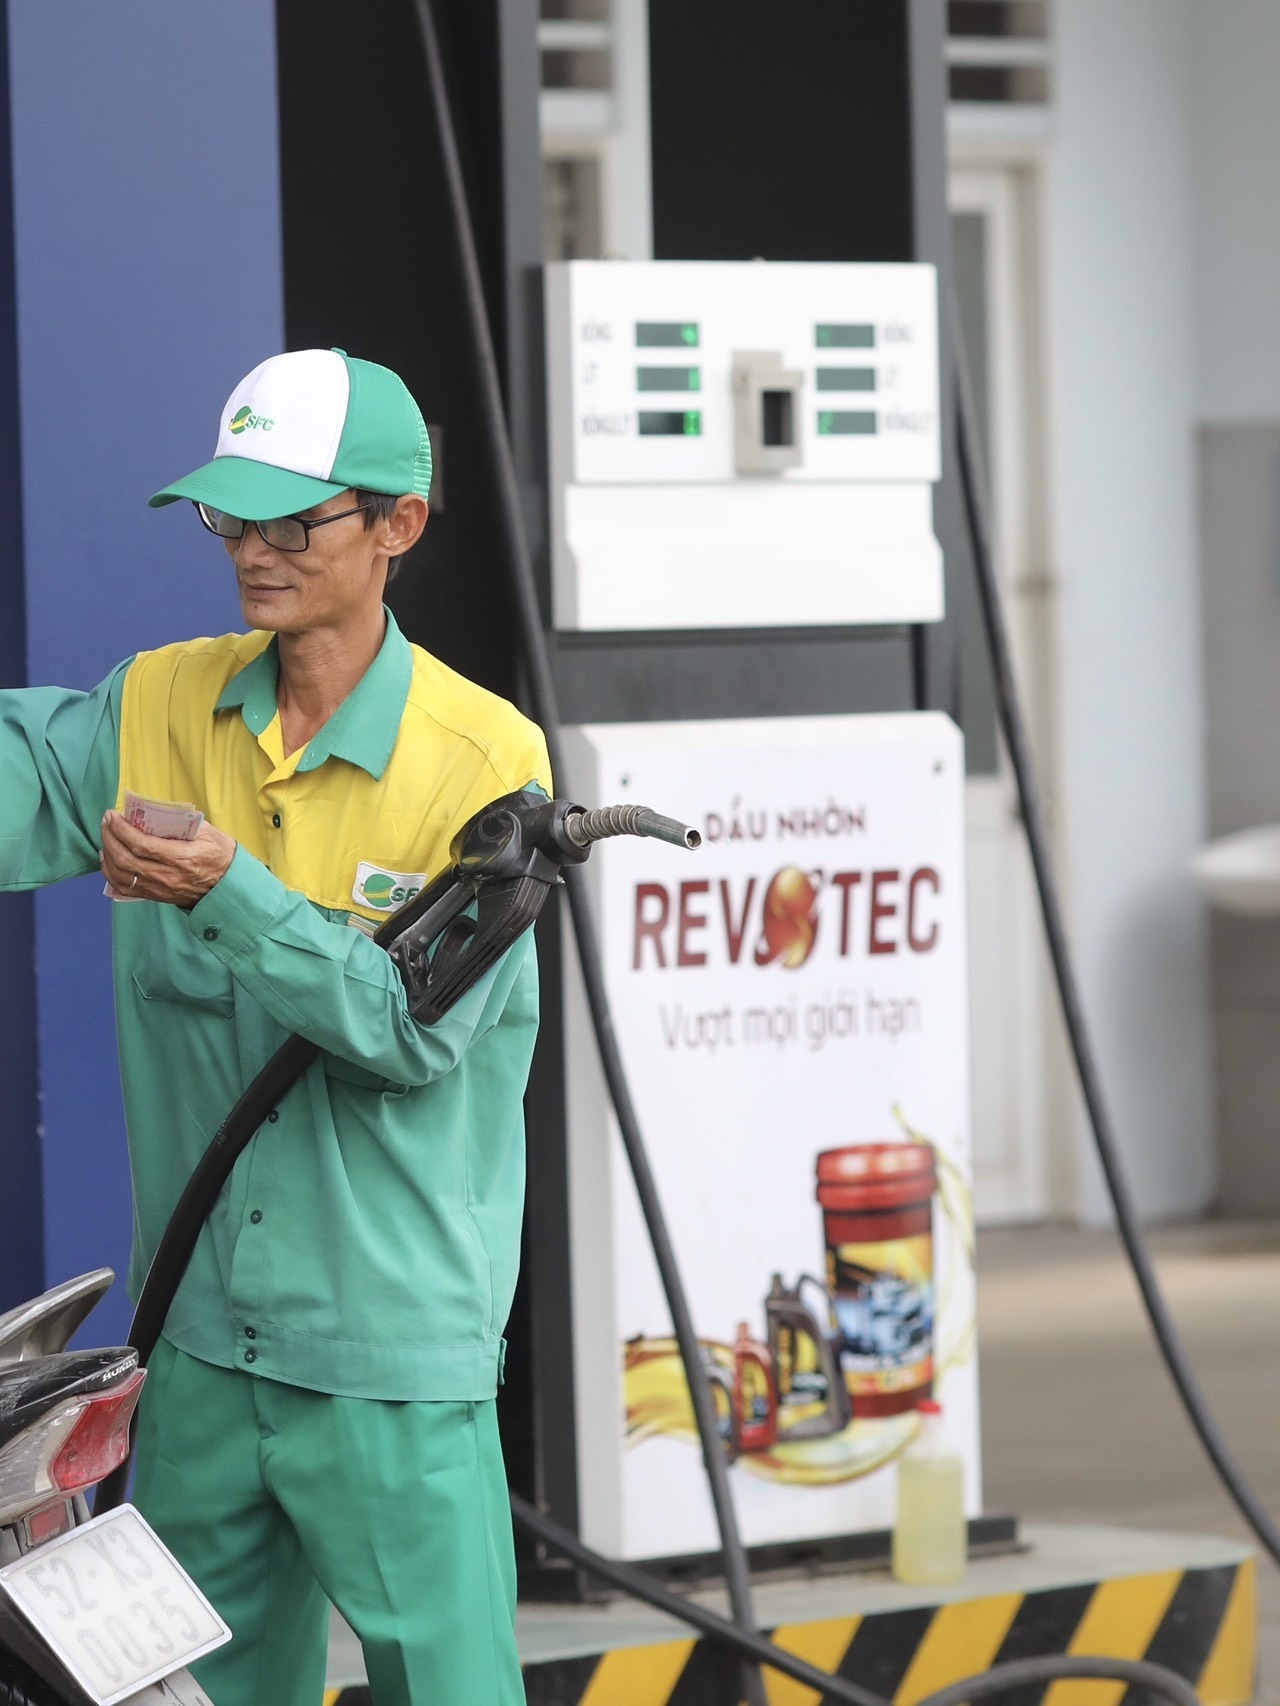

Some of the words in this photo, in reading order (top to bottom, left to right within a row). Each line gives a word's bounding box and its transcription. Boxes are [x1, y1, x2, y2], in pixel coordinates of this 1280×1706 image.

[245, 415, 276, 431] SFC
[391, 887, 420, 902] SF
[631, 865, 941, 972] REVOTEC
[76, 1585, 200, 1683] 0035
